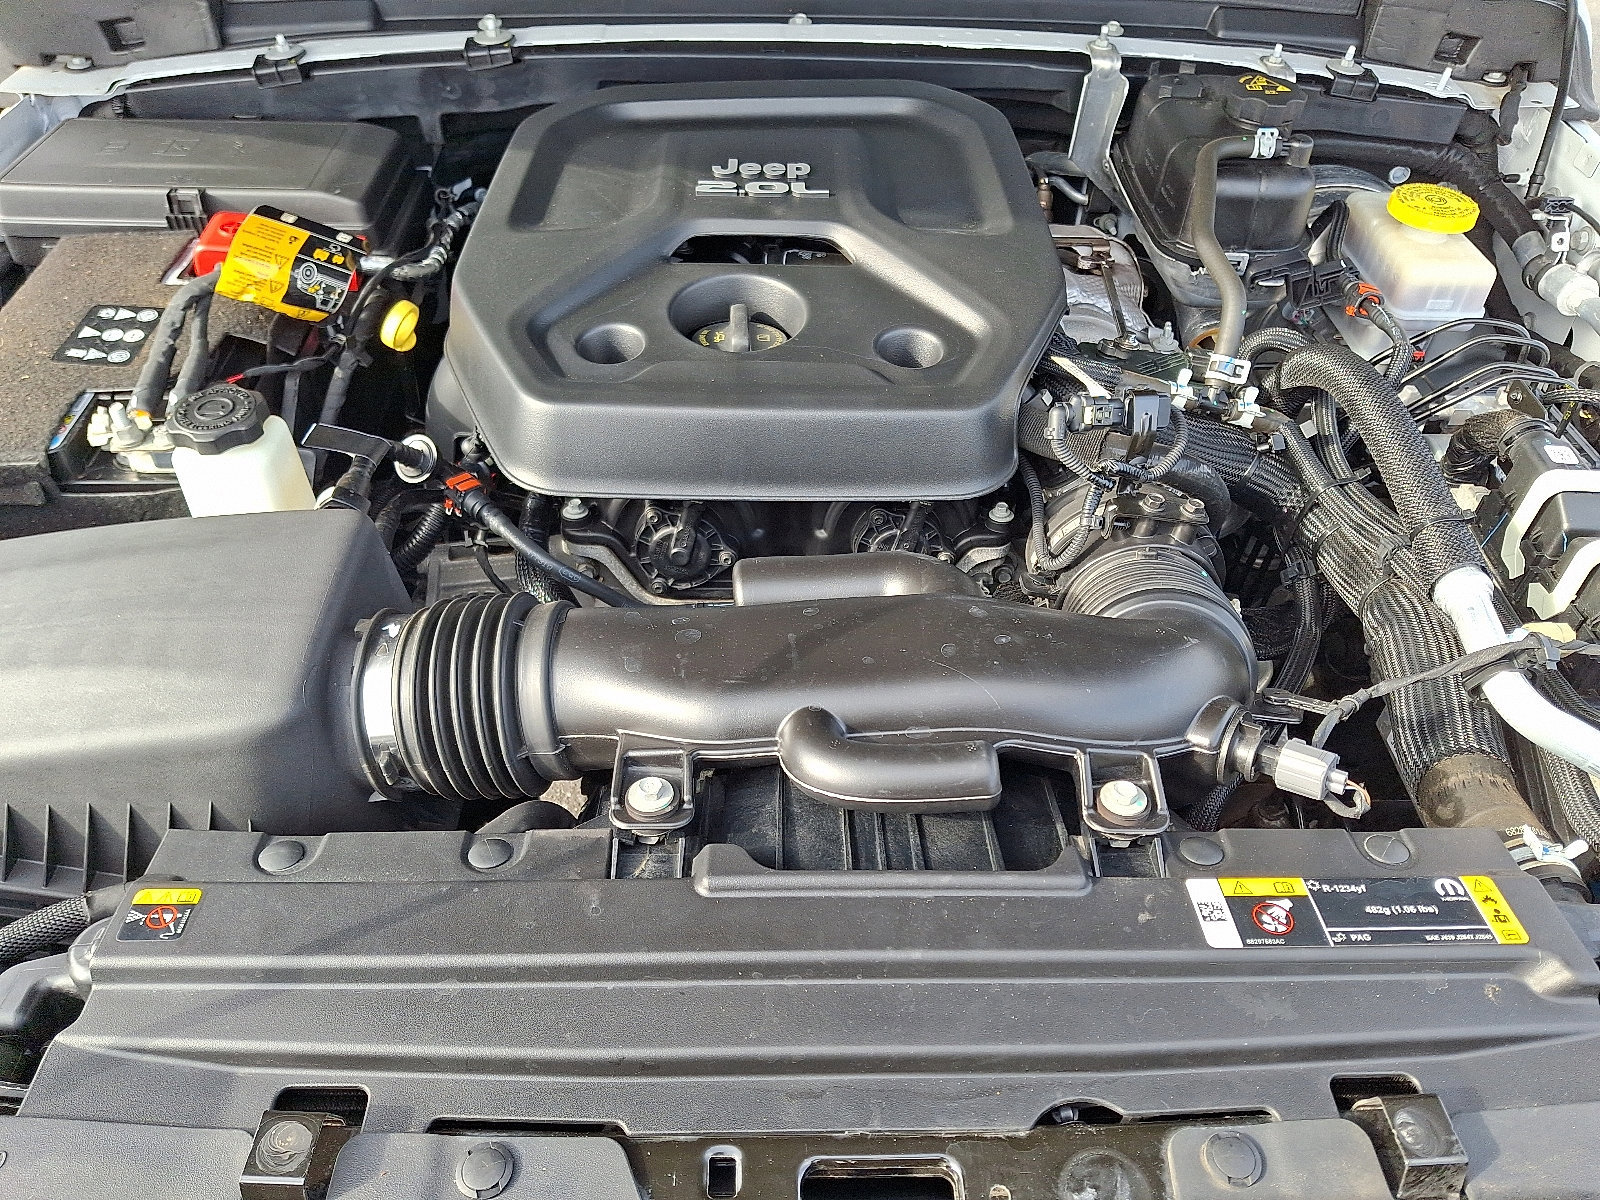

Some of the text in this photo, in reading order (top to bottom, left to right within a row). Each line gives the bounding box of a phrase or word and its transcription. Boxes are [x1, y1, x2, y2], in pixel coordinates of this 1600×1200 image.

[712, 158, 811, 181] Jeep
[695, 180, 830, 198] 2.0L
[1350, 933, 1372, 942] PAG
